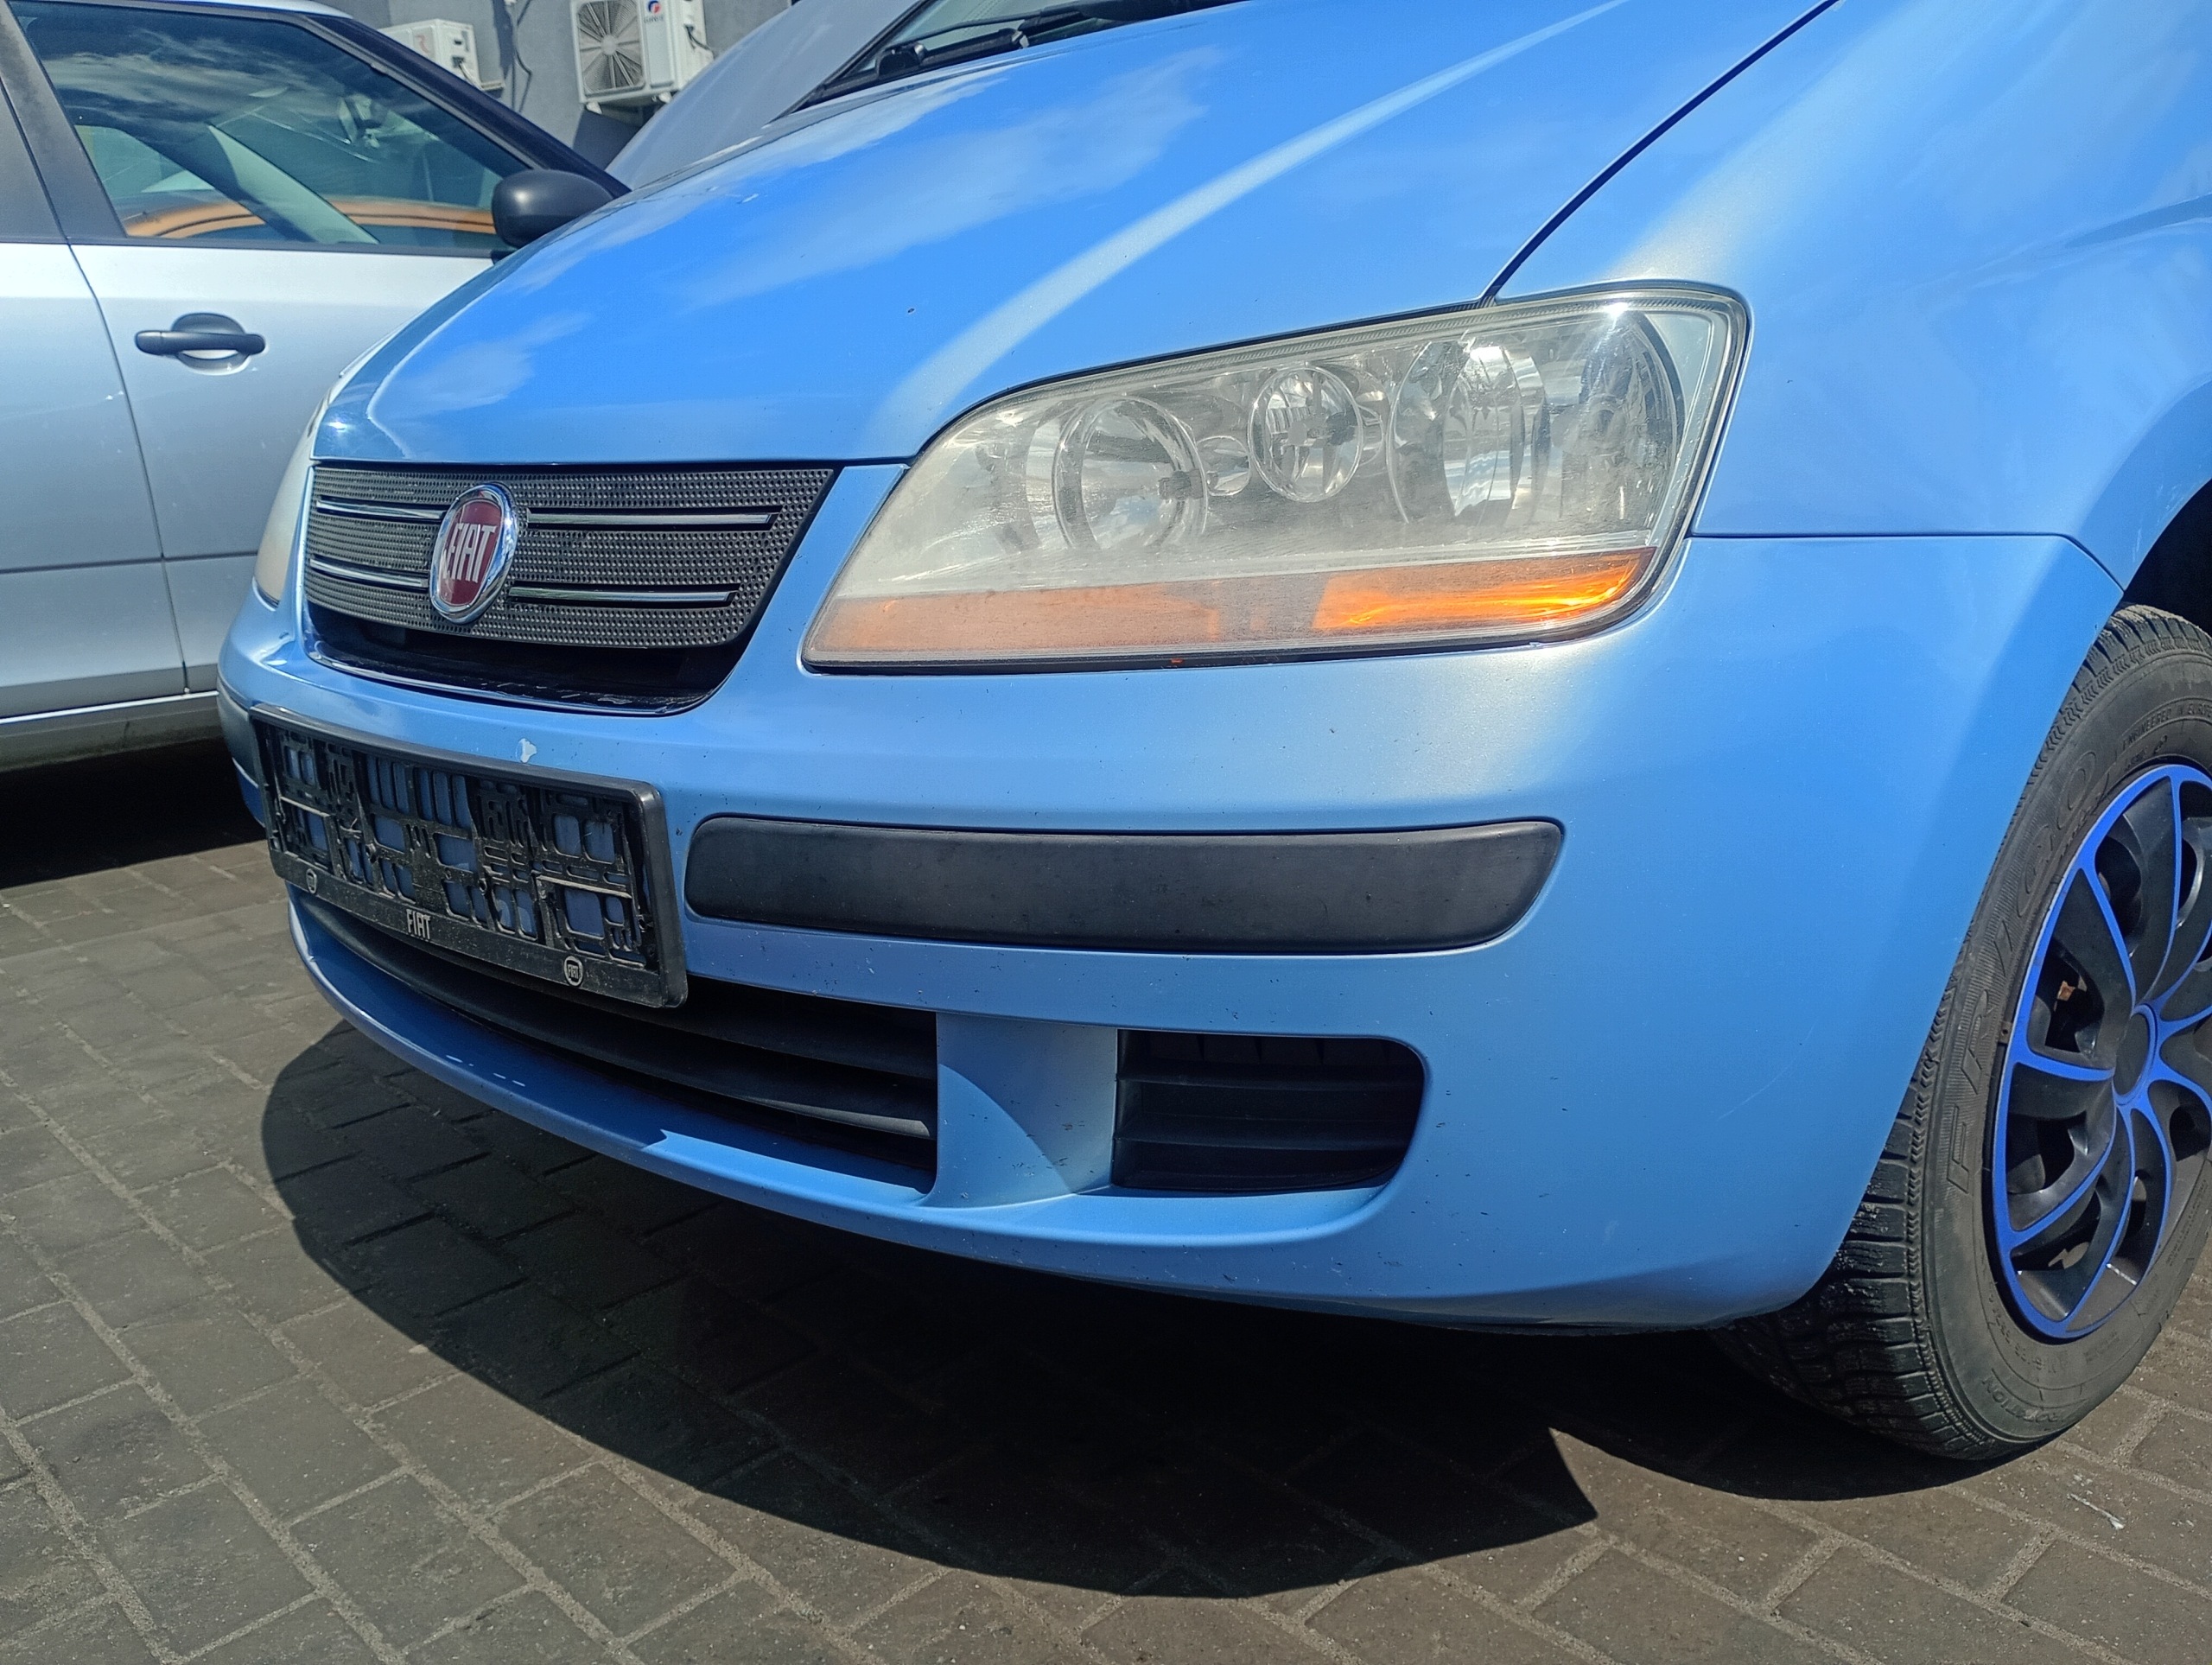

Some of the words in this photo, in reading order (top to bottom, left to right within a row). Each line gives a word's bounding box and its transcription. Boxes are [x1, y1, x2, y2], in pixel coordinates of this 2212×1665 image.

[442, 522, 498, 584] FIAT
[406, 908, 431, 940] FIAT
[1947, 749, 2097, 1195] FRIGO
